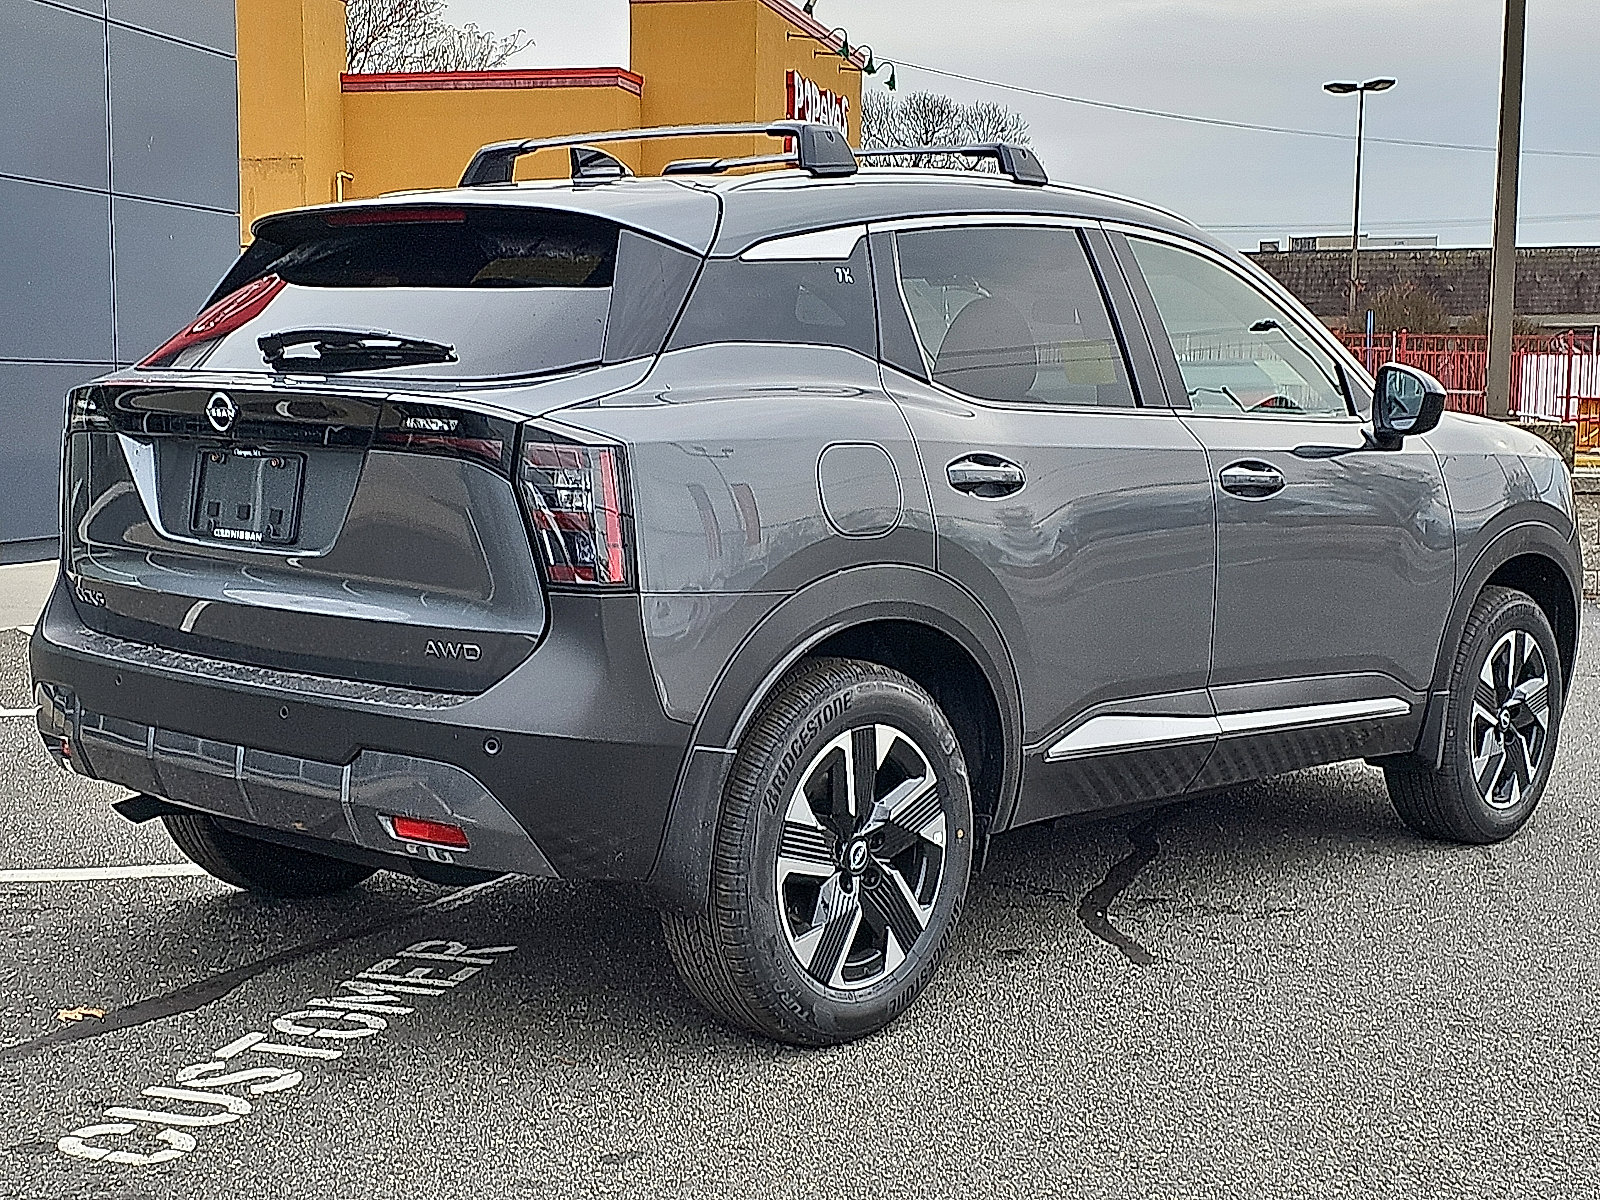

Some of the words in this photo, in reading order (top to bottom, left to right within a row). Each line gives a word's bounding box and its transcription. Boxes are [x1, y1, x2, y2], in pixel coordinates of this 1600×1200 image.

[425, 640, 481, 660] AWD
[763, 689, 854, 816] BRIDGESTONE
[57, 940, 517, 1166] CUSTOMER
